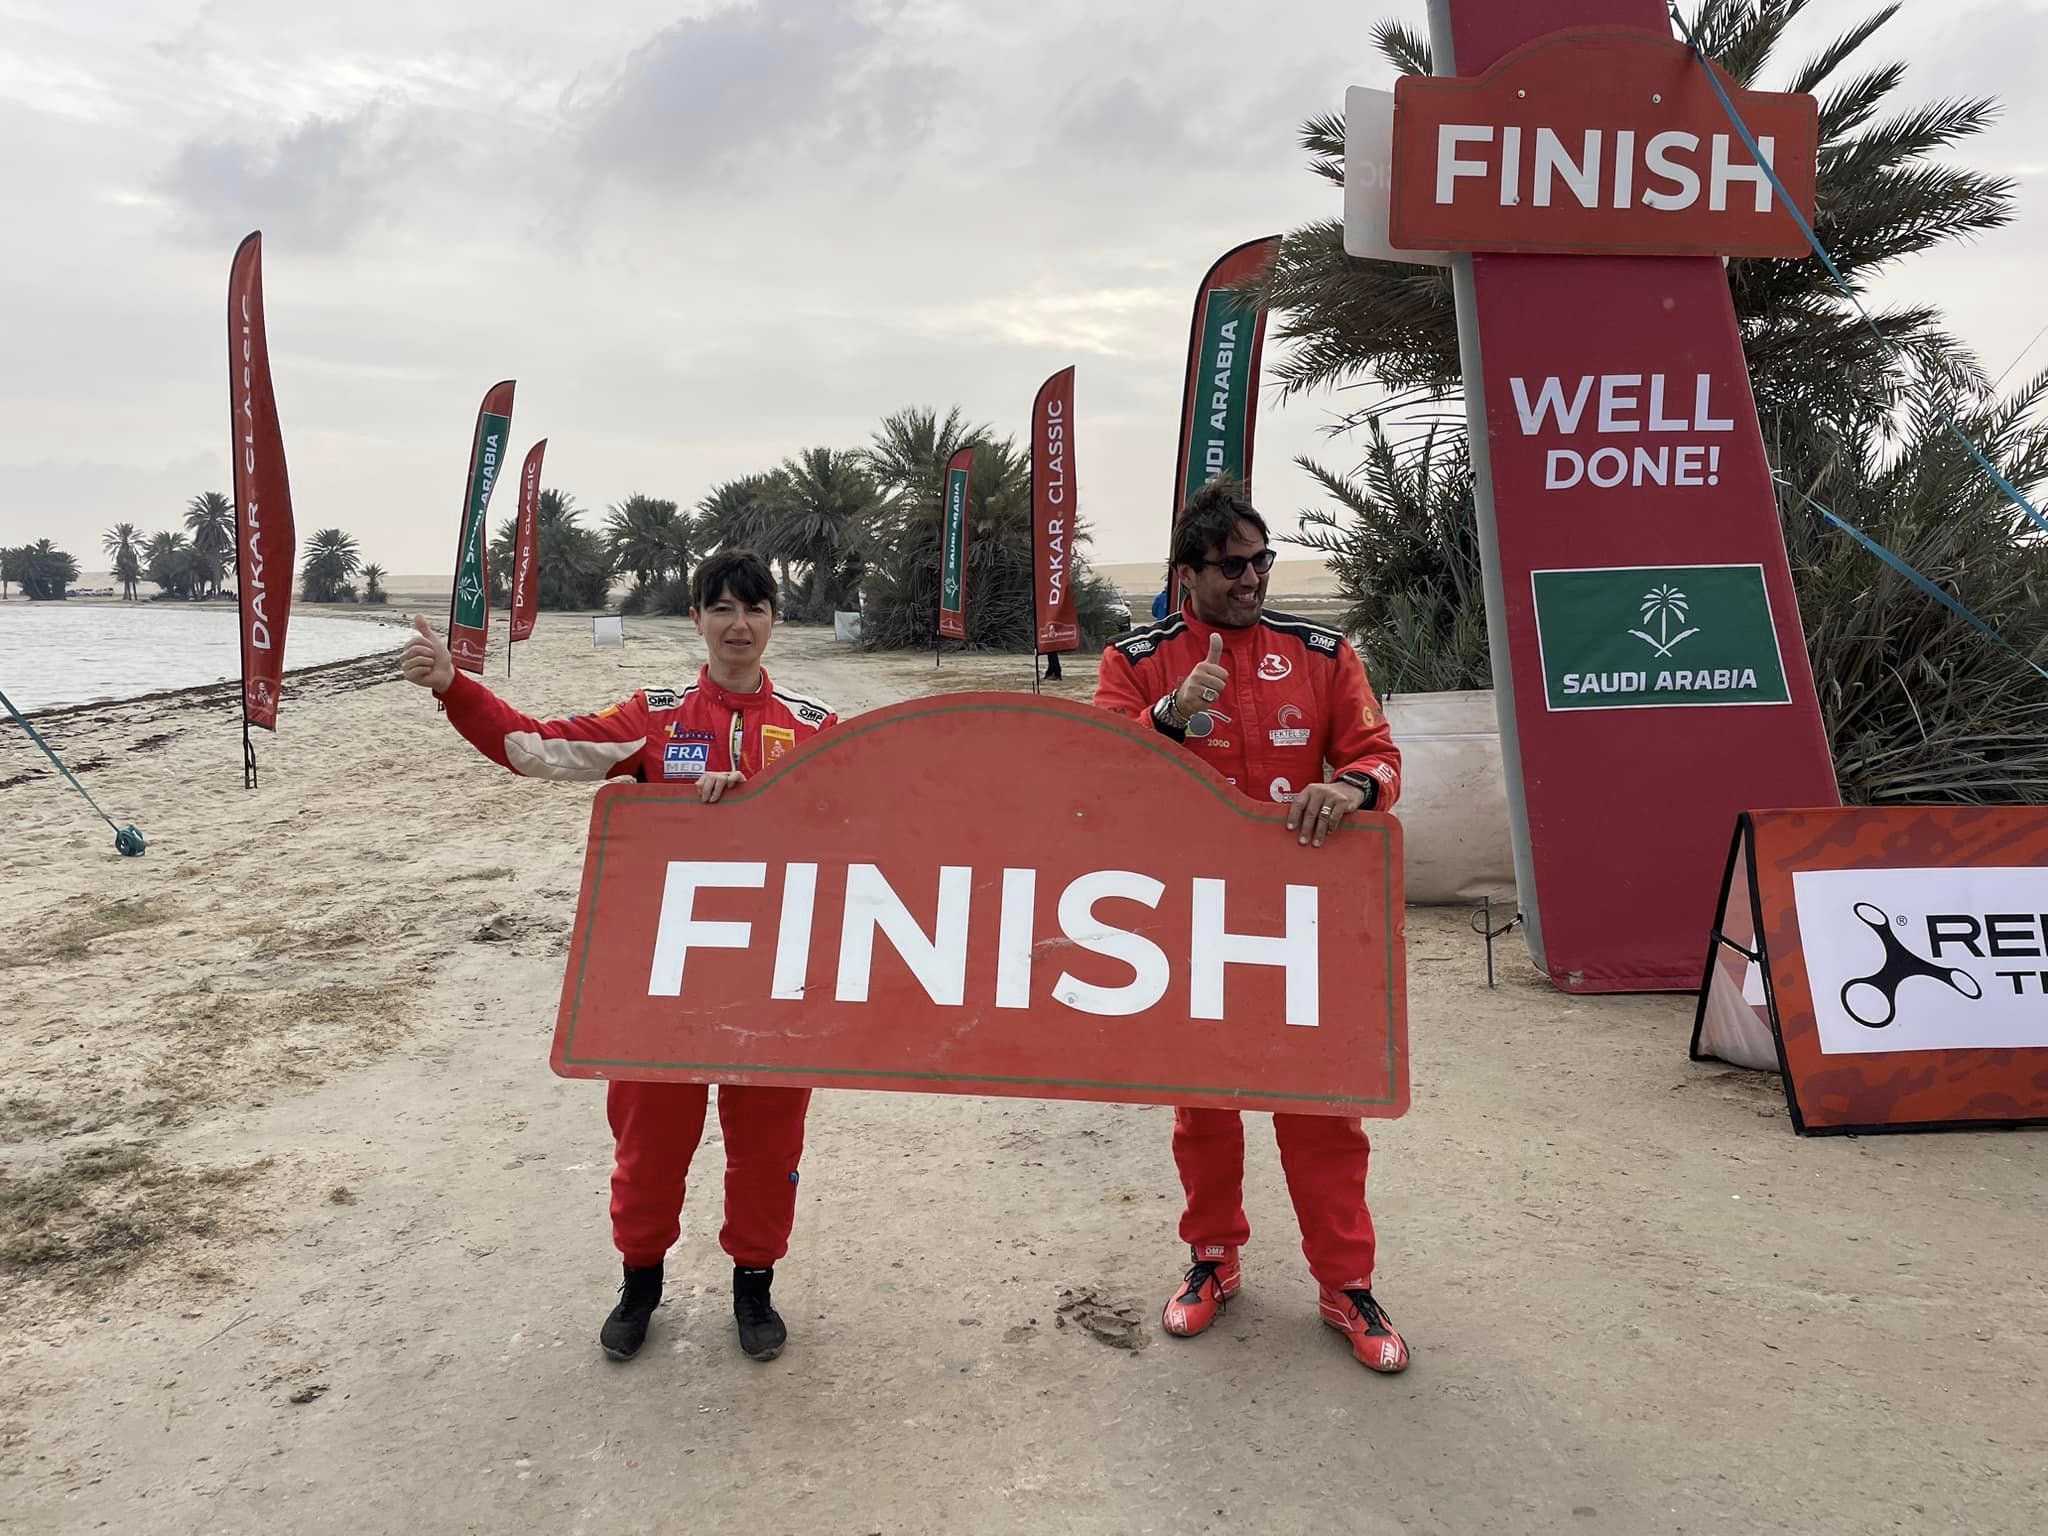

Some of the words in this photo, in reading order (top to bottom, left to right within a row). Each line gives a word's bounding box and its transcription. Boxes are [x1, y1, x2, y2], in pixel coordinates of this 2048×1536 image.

[1436, 124, 1775, 213] FINISH
[1210, 319, 1239, 431] ARABIA
[1509, 374, 1735, 435] WELL
[481, 434, 499, 504] ARABIA
[1048, 399, 1063, 504] CLASSIC
[1545, 446, 1721, 489] DONE!
[515, 546, 530, 607] DAKAR
[525, 461, 537, 536] CLASSIC
[248, 502, 271, 649] DAKAR
[1048, 519, 1064, 605] DAKAR
[1128, 641, 1152, 655] OMP
[1310, 635, 1336, 648] OMP
[648, 694, 675, 707] OMP
[1563, 672, 1647, 694] SAUDI
[1654, 669, 1757, 691] ARABIA
[799, 706, 824, 722] OMP
[667, 746, 704, 759] FRA
[1207, 738, 1231, 749] 2000
[666, 763, 703, 772] MED
[648, 861, 1320, 1027] FINISH
[1926, 914, 2048, 958] RE
[1205, 1246, 1225, 1256] OMP
